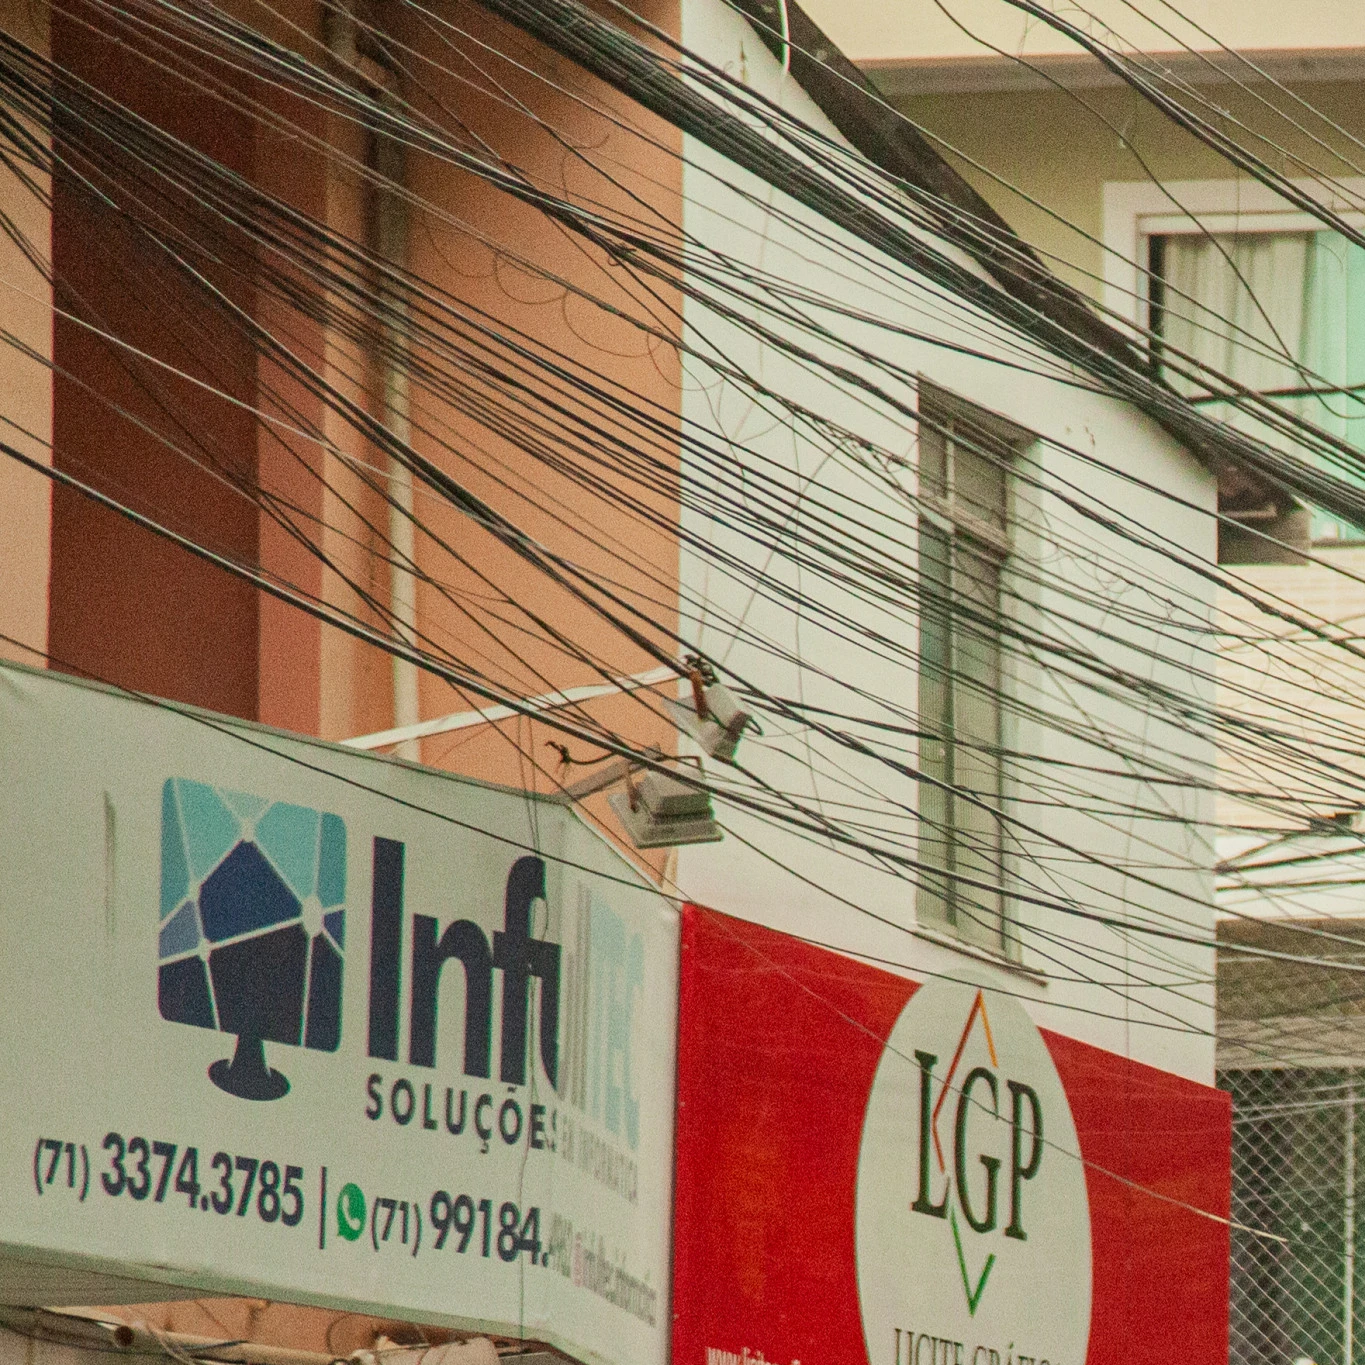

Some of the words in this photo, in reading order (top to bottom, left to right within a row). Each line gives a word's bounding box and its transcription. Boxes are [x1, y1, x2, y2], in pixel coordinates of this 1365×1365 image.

[34, 1137, 89, 1202] (71)
[101, 1132, 304, 1228] 3374.3785
[910, 1049, 1044, 1241] LGP
[371, 1196, 423, 1257] (71)
